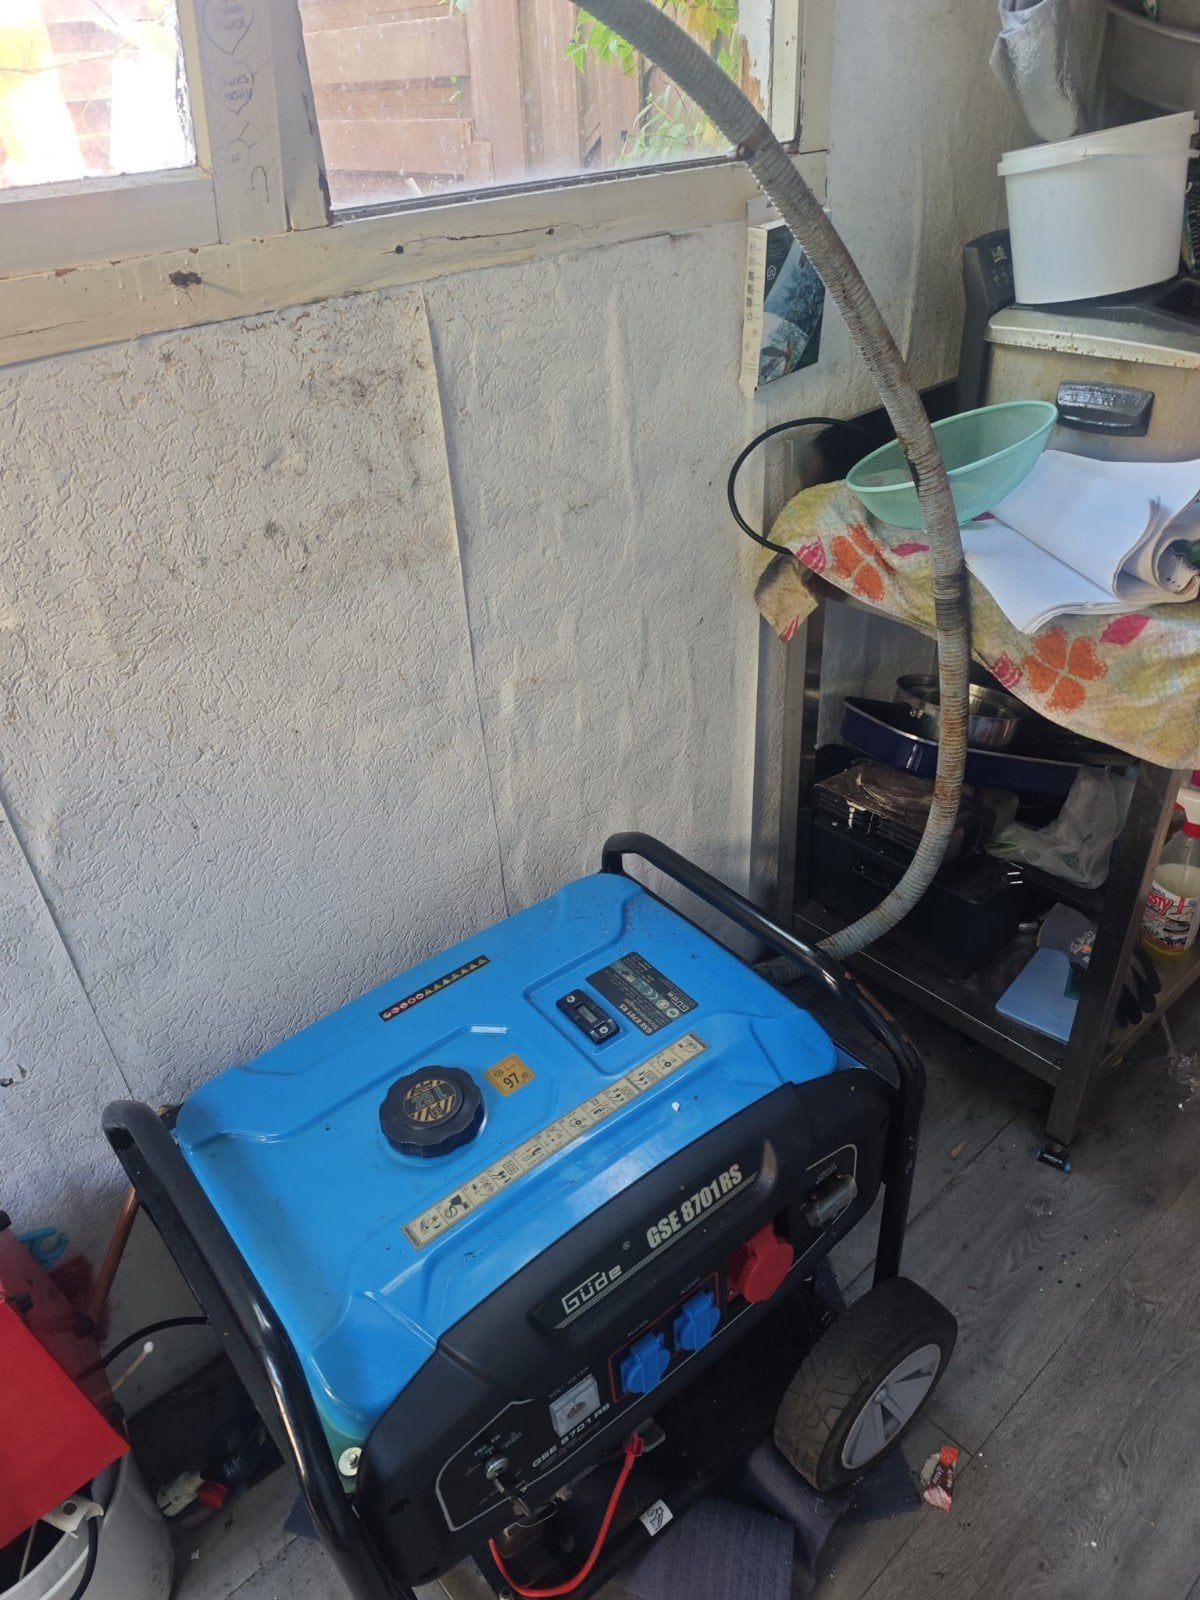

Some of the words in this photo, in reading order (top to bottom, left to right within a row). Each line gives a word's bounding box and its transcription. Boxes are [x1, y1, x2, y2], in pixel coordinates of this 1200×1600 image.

[502, 1072, 520, 1089] 97
[411, 1091, 435, 1111] 25
[646, 1210, 682, 1249] GSE
[532, 1444, 558, 1468] GSE
[560, 1418, 593, 1445] 8701
[594, 1402, 611, 1419] RS
